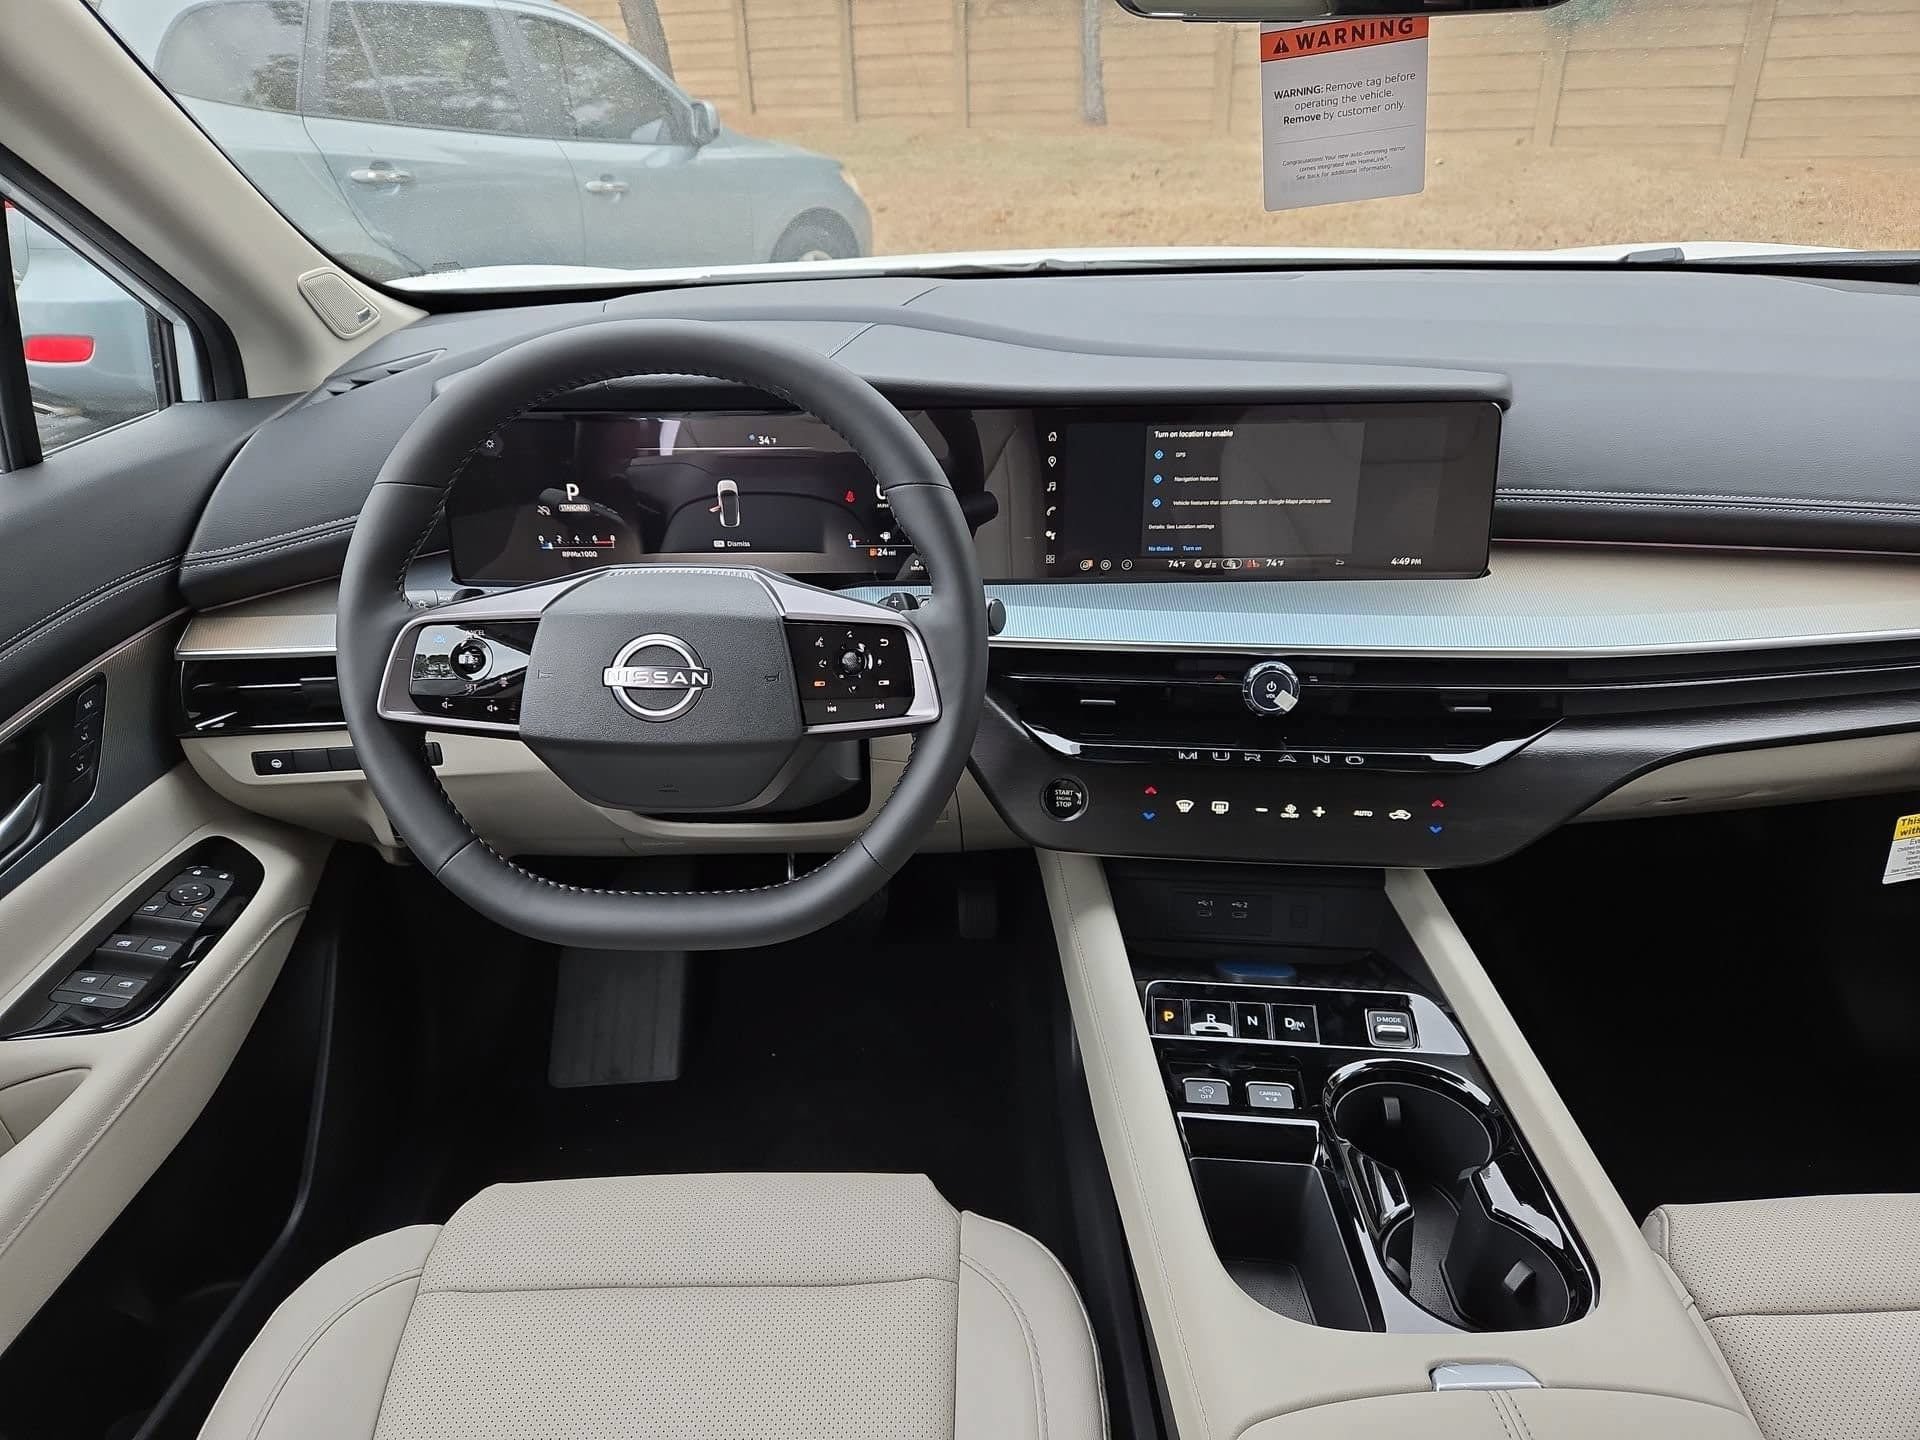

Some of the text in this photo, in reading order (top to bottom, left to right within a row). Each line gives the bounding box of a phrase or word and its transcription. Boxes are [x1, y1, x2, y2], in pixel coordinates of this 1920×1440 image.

[1295, 17, 1413, 51] WARNING
[1274, 72, 1416, 99] WARNING: Remove tag before
[1294, 88, 1394, 111] operating the vehicle.
[1283, 100, 1406, 125] Remove by customer only.
[1351, 148, 1388, 158] auto-dimming
[1318, 162, 1345, 170] integrated
[1154, 430, 1169, 438] Turn
[1179, 430, 1204, 438] location
[1212, 429, 1234, 437] enable
[566, 483, 580, 502] P
[727, 540, 751, 548] Dismiss
[877, 548, 888, 556] 24
[1390, 557, 1422, 566] 4:49 PM
[606, 670, 709, 686] NISSAN
[1177, 750, 1365, 766] MURANO
[1163, 1011, 1174, 1022] P
[1206, 1013, 1216, 1024] R
[1247, 1015, 1259, 1027] N
